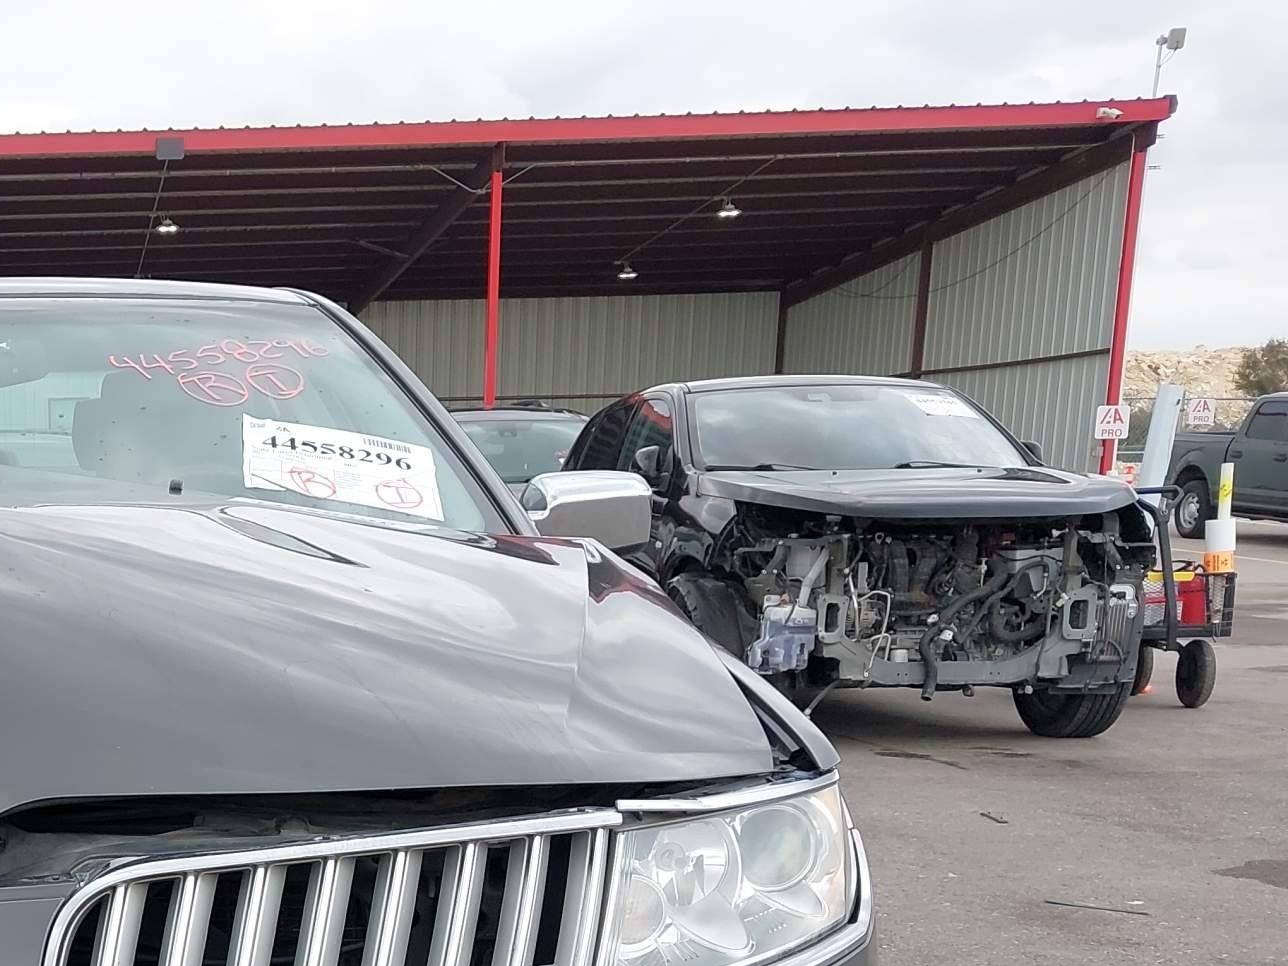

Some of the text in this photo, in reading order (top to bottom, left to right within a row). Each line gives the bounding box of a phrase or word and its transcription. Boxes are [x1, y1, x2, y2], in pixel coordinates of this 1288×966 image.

[109, 339, 329, 379] 44558296
[1193, 415, 1210, 423] PRO
[1101, 428, 1122, 437] PRO
[262, 435, 412, 470] 44558296
